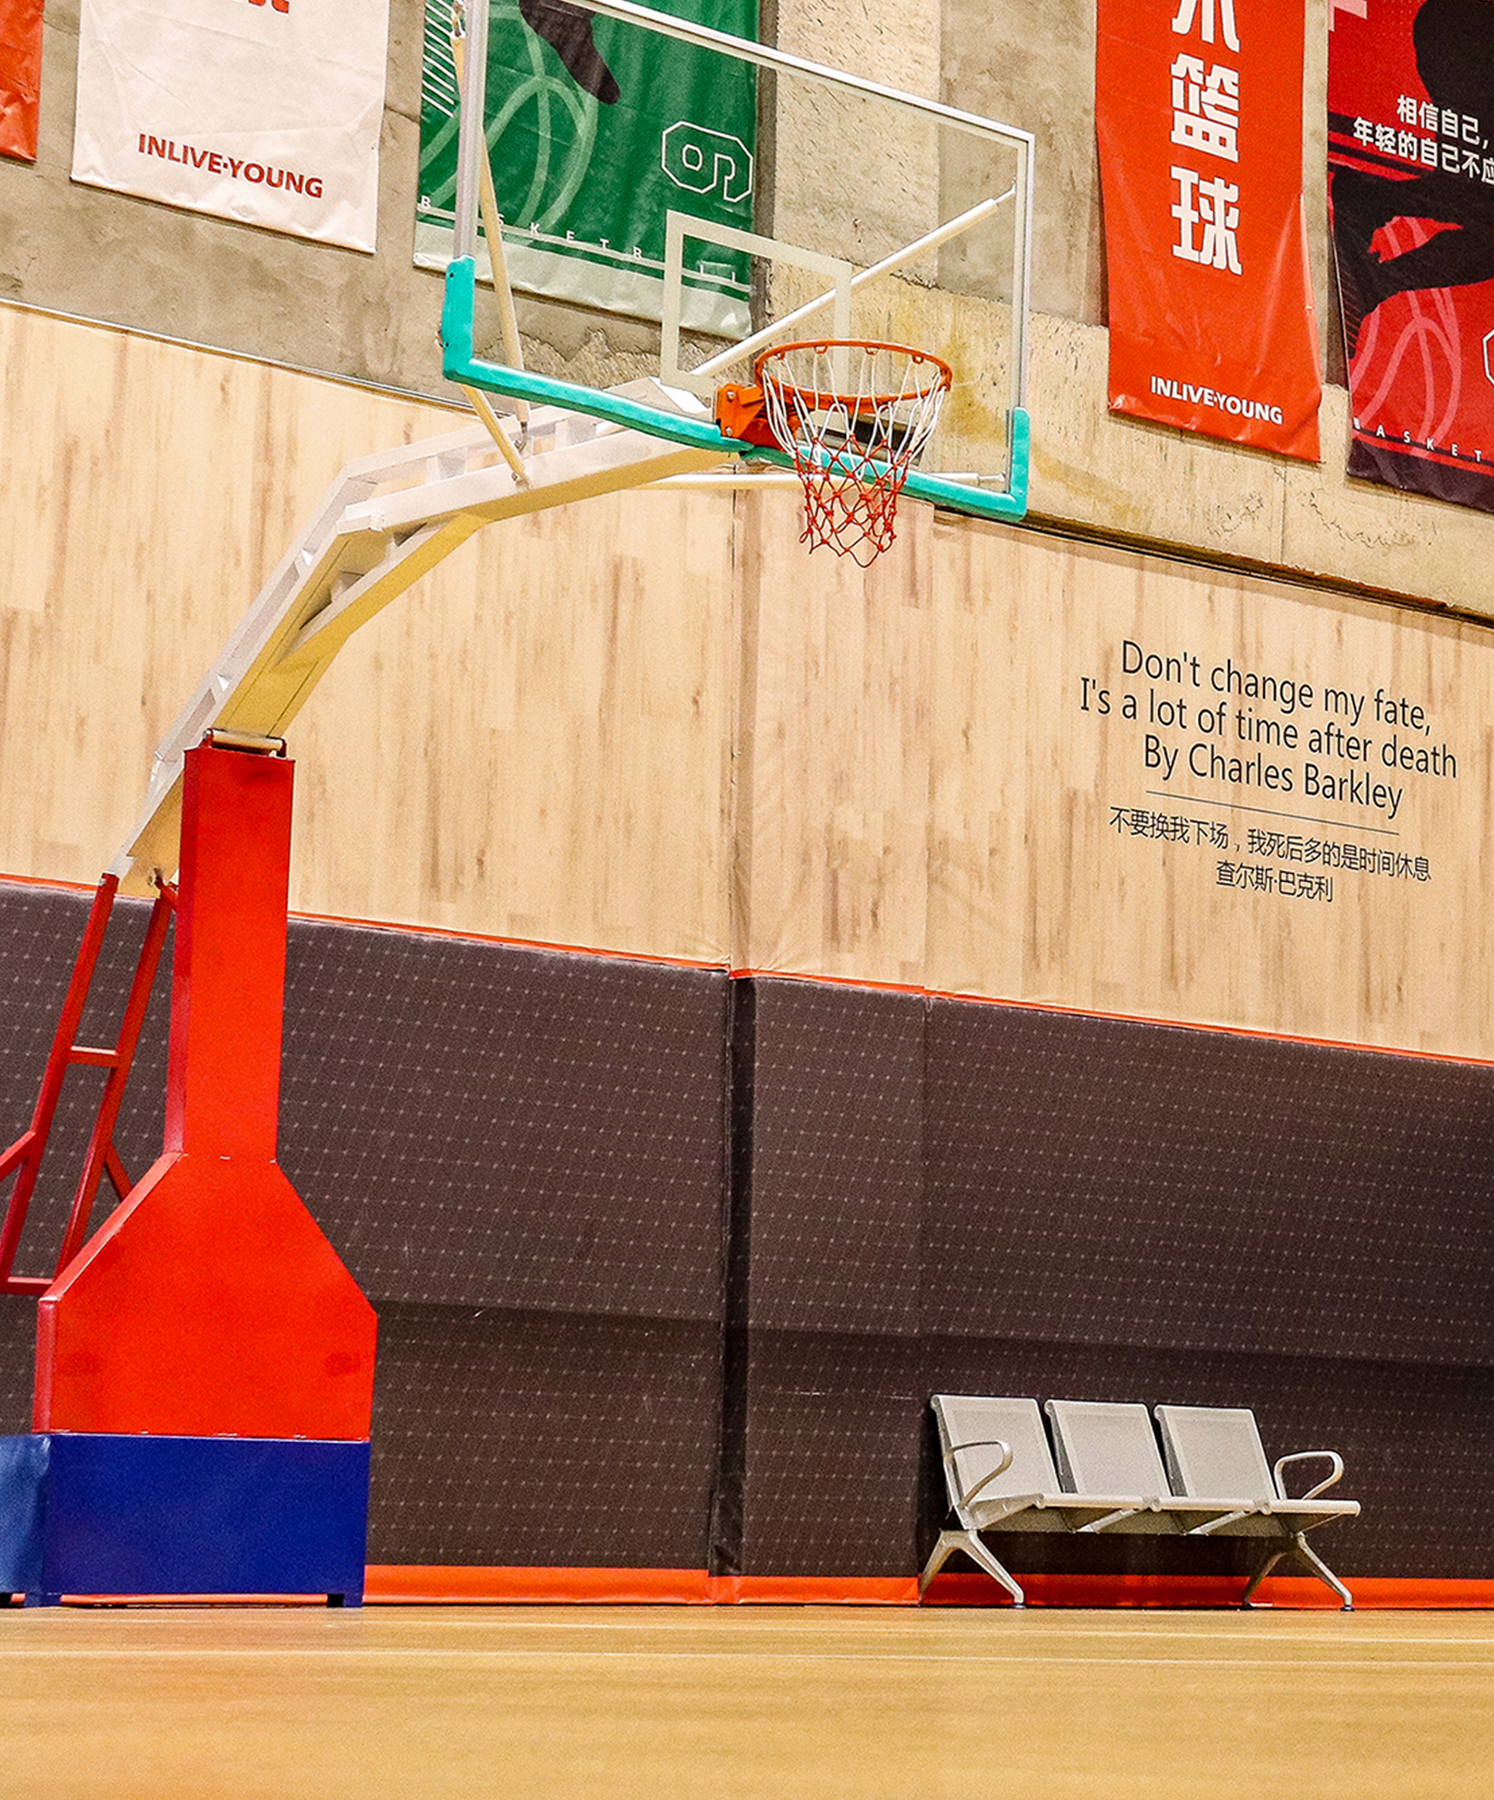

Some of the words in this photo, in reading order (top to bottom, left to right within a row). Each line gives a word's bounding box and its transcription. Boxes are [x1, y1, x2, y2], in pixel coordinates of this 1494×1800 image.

[421, 196, 738, 283] BSKETBLL
[1080, 678, 1111, 715] I's
[1122, 694, 1137, 720] a
[1150, 689, 1187, 730] lot
[1197, 701, 1227, 736] of
[1235, 707, 1299, 749] time
[1309, 723, 1372, 762] after
[1382, 736, 1458, 779] death
[1122, 640, 1200, 687] Don't
[1211, 659, 1314, 714] change
[1325, 686, 1365, 727] my
[1374, 689, 1432, 737] fate,
[1145, 735, 1178, 780] By
[1189, 743, 1294, 792] Charles
[1305, 763, 1403, 820] Barkley
